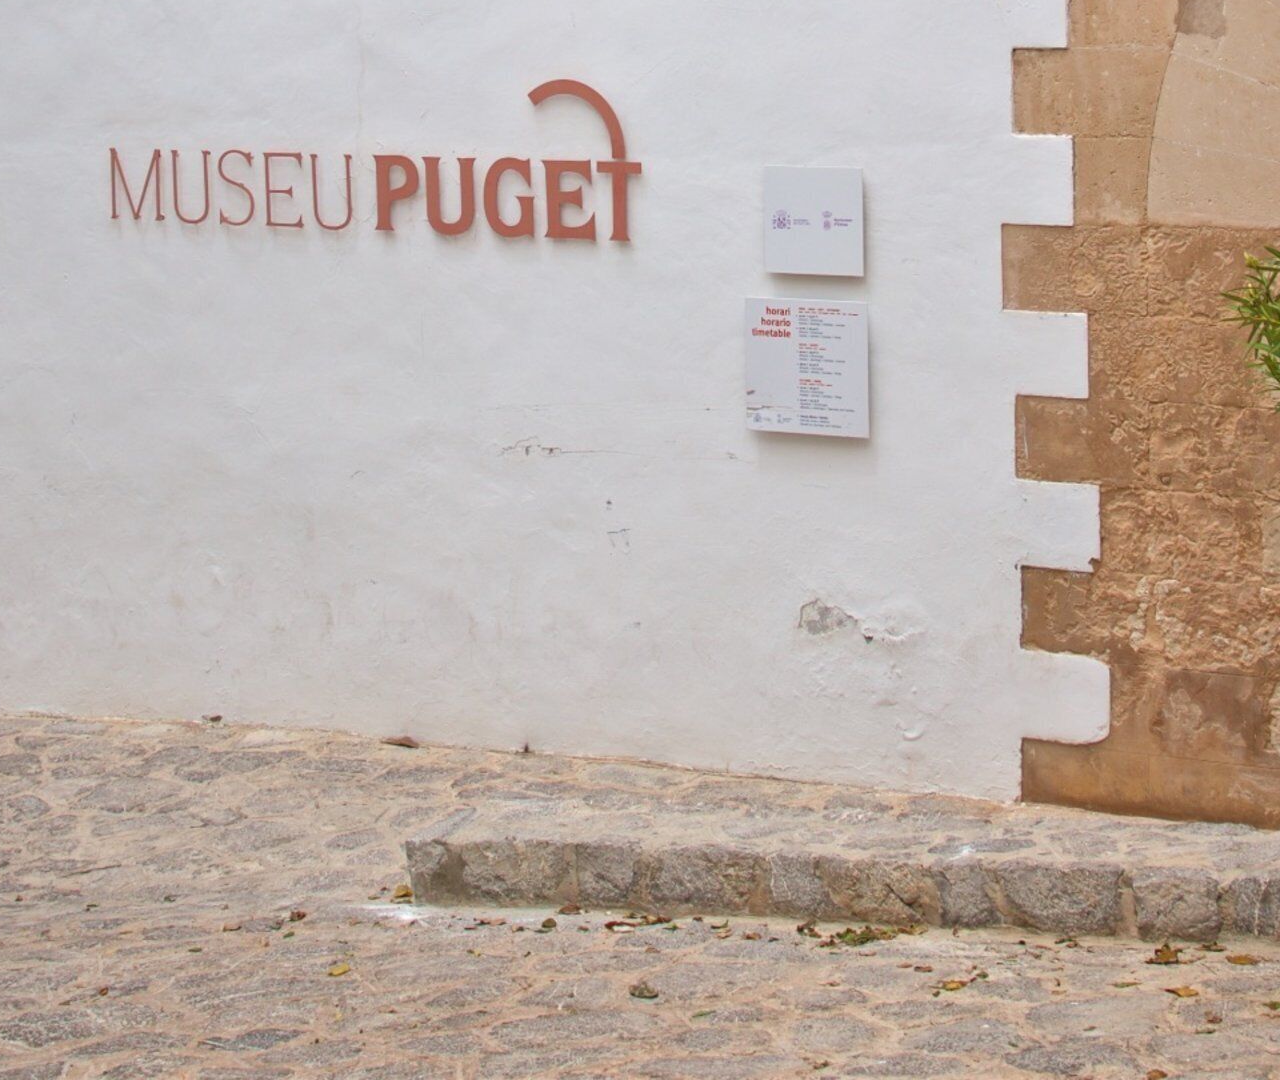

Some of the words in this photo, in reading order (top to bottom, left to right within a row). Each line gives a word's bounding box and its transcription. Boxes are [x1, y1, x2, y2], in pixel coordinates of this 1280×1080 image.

[108, 146, 354, 231] MUSEU
[373, 151, 643, 243] PUGET
[765, 305, 791, 316] horari
[760, 316, 792, 327] horario
[751, 327, 792, 338] timetable
